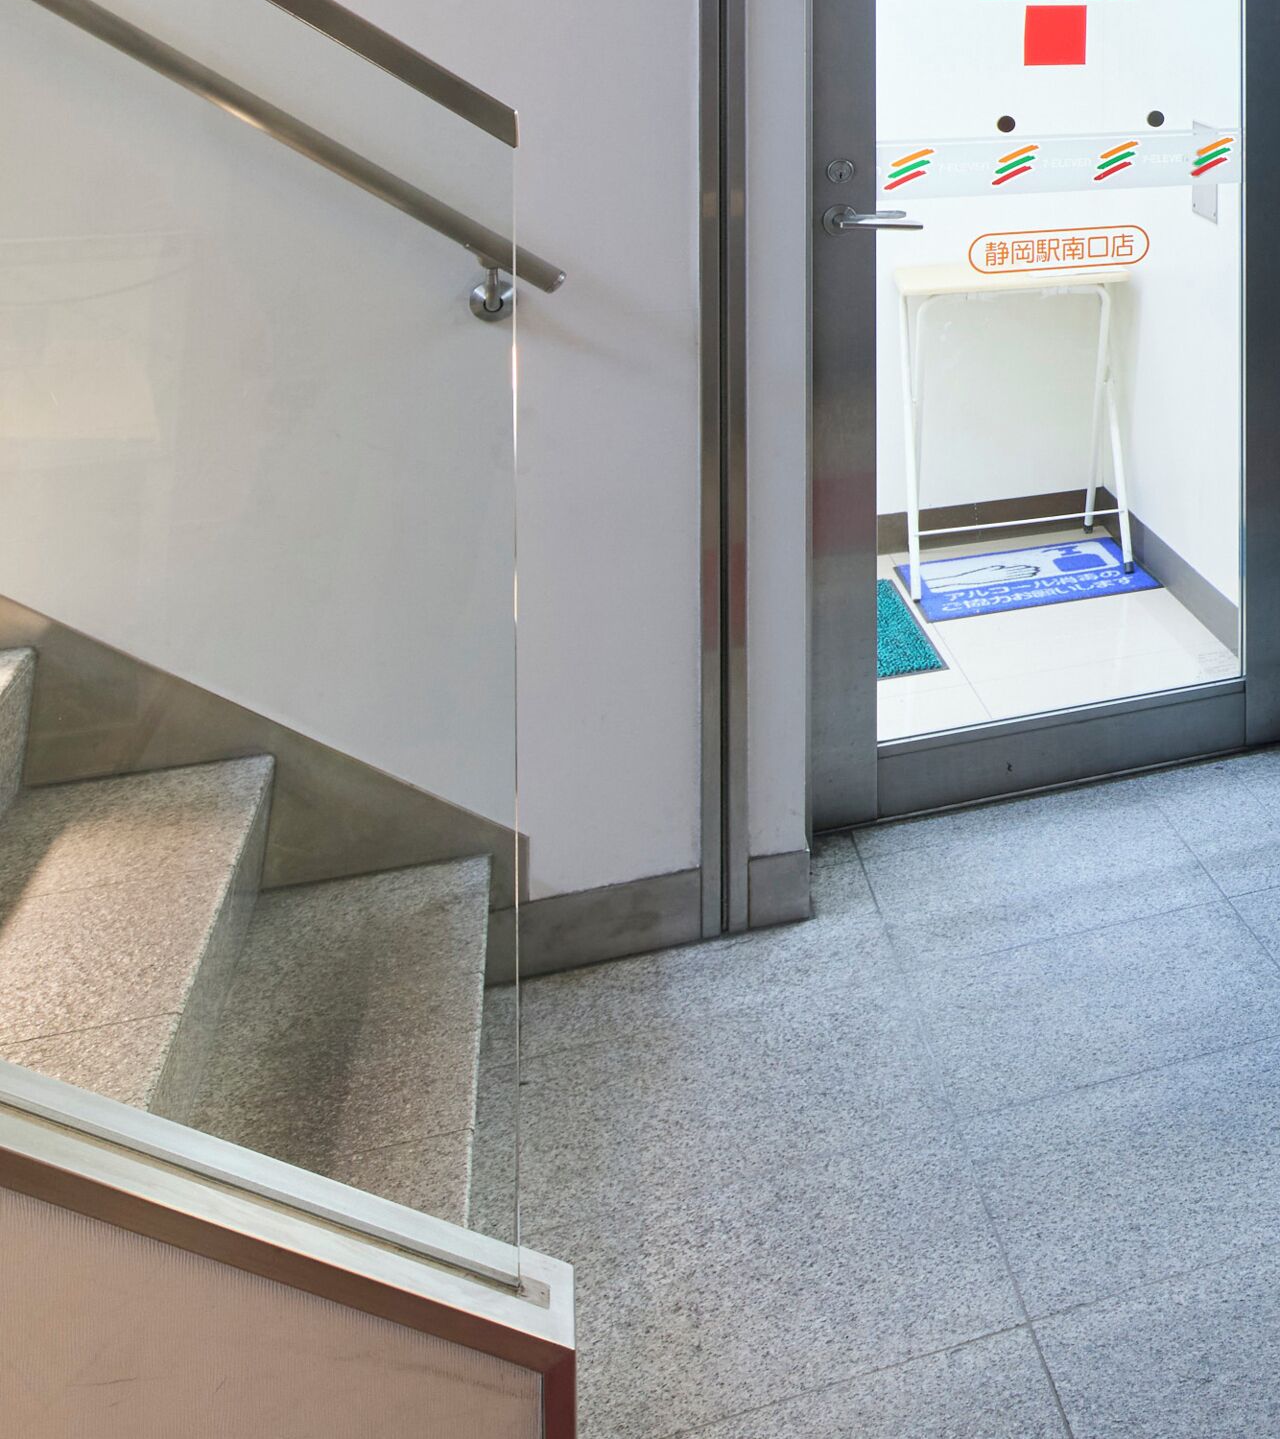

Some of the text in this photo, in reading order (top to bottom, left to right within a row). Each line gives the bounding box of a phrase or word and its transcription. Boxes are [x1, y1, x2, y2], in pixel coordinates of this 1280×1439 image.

[984, 233, 1134, 267] 静岡駅南口店
[941, 574, 1134, 612] ご協力お願いします
[947, 568, 1121, 602] アルコール消毒の
